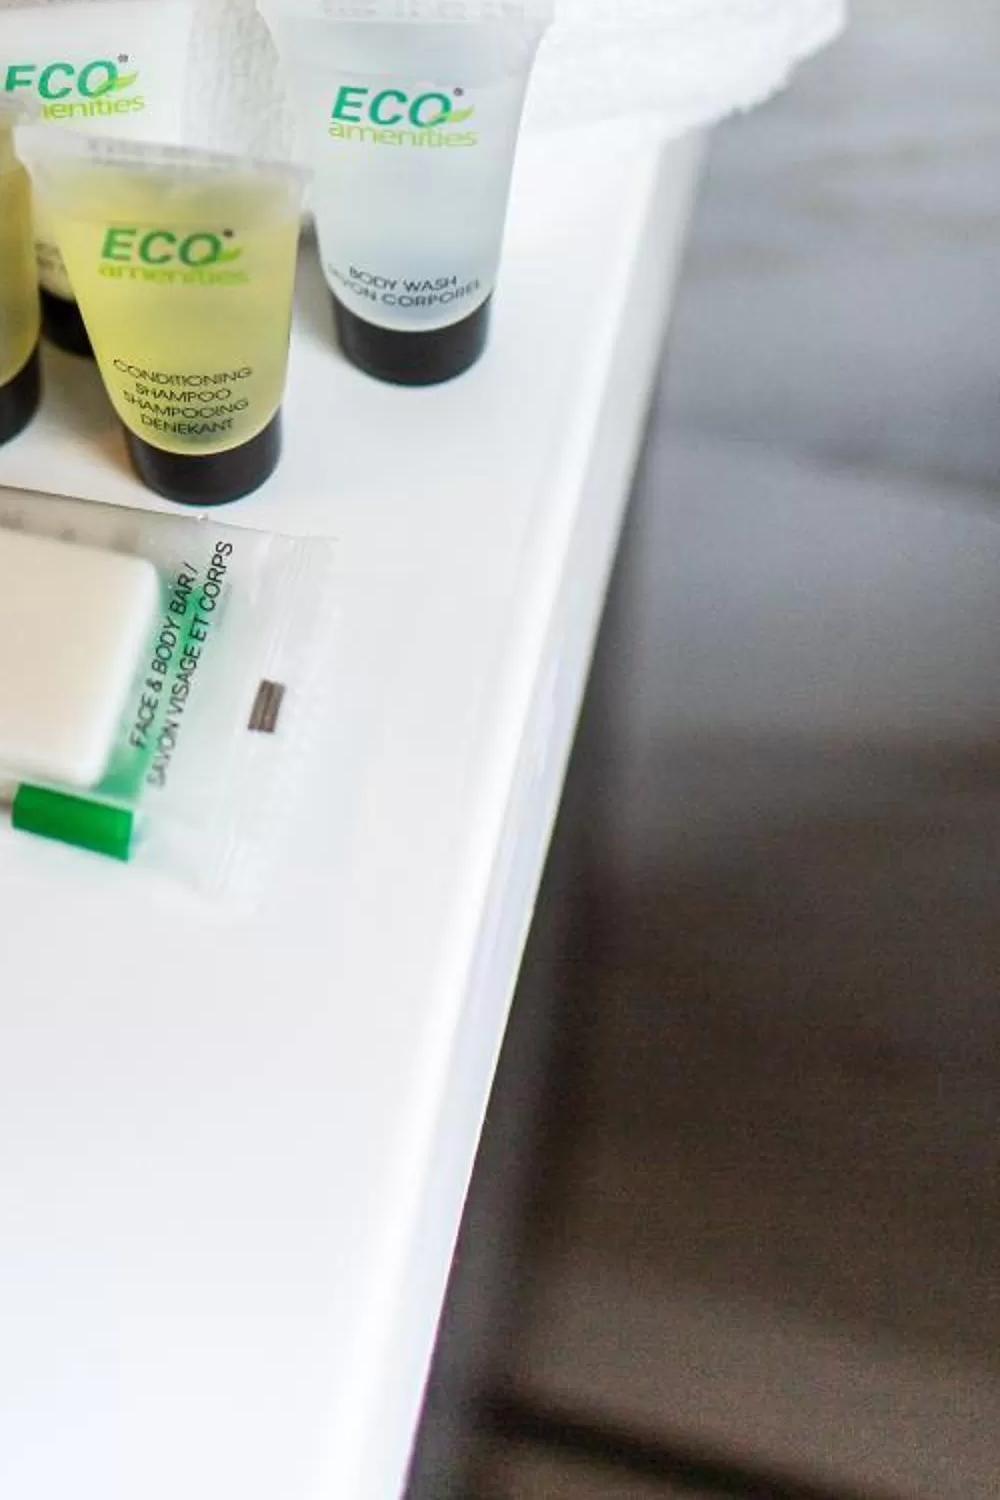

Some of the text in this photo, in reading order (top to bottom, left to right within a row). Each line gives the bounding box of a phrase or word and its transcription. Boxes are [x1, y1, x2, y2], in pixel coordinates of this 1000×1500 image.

[41, 96, 145, 119] enities
[330, 85, 453, 129] ECO
[327, 120, 478, 148] amenities
[101, 227, 223, 267] ECO
[348, 265, 457, 293] BODY WASH
[113, 359, 253, 387] CONDITIONING
[122, 389, 250, 420] SHAMPOOING
[134, 382, 233, 403] SHAMPOO
[164, 643, 202, 715] VISAGE
[189, 612, 209, 643] ET
[199, 540, 233, 613] CORPS
[151, 615, 181, 676] BODY
[145, 678, 163, 693] &
[128, 691, 159, 751] FACE
